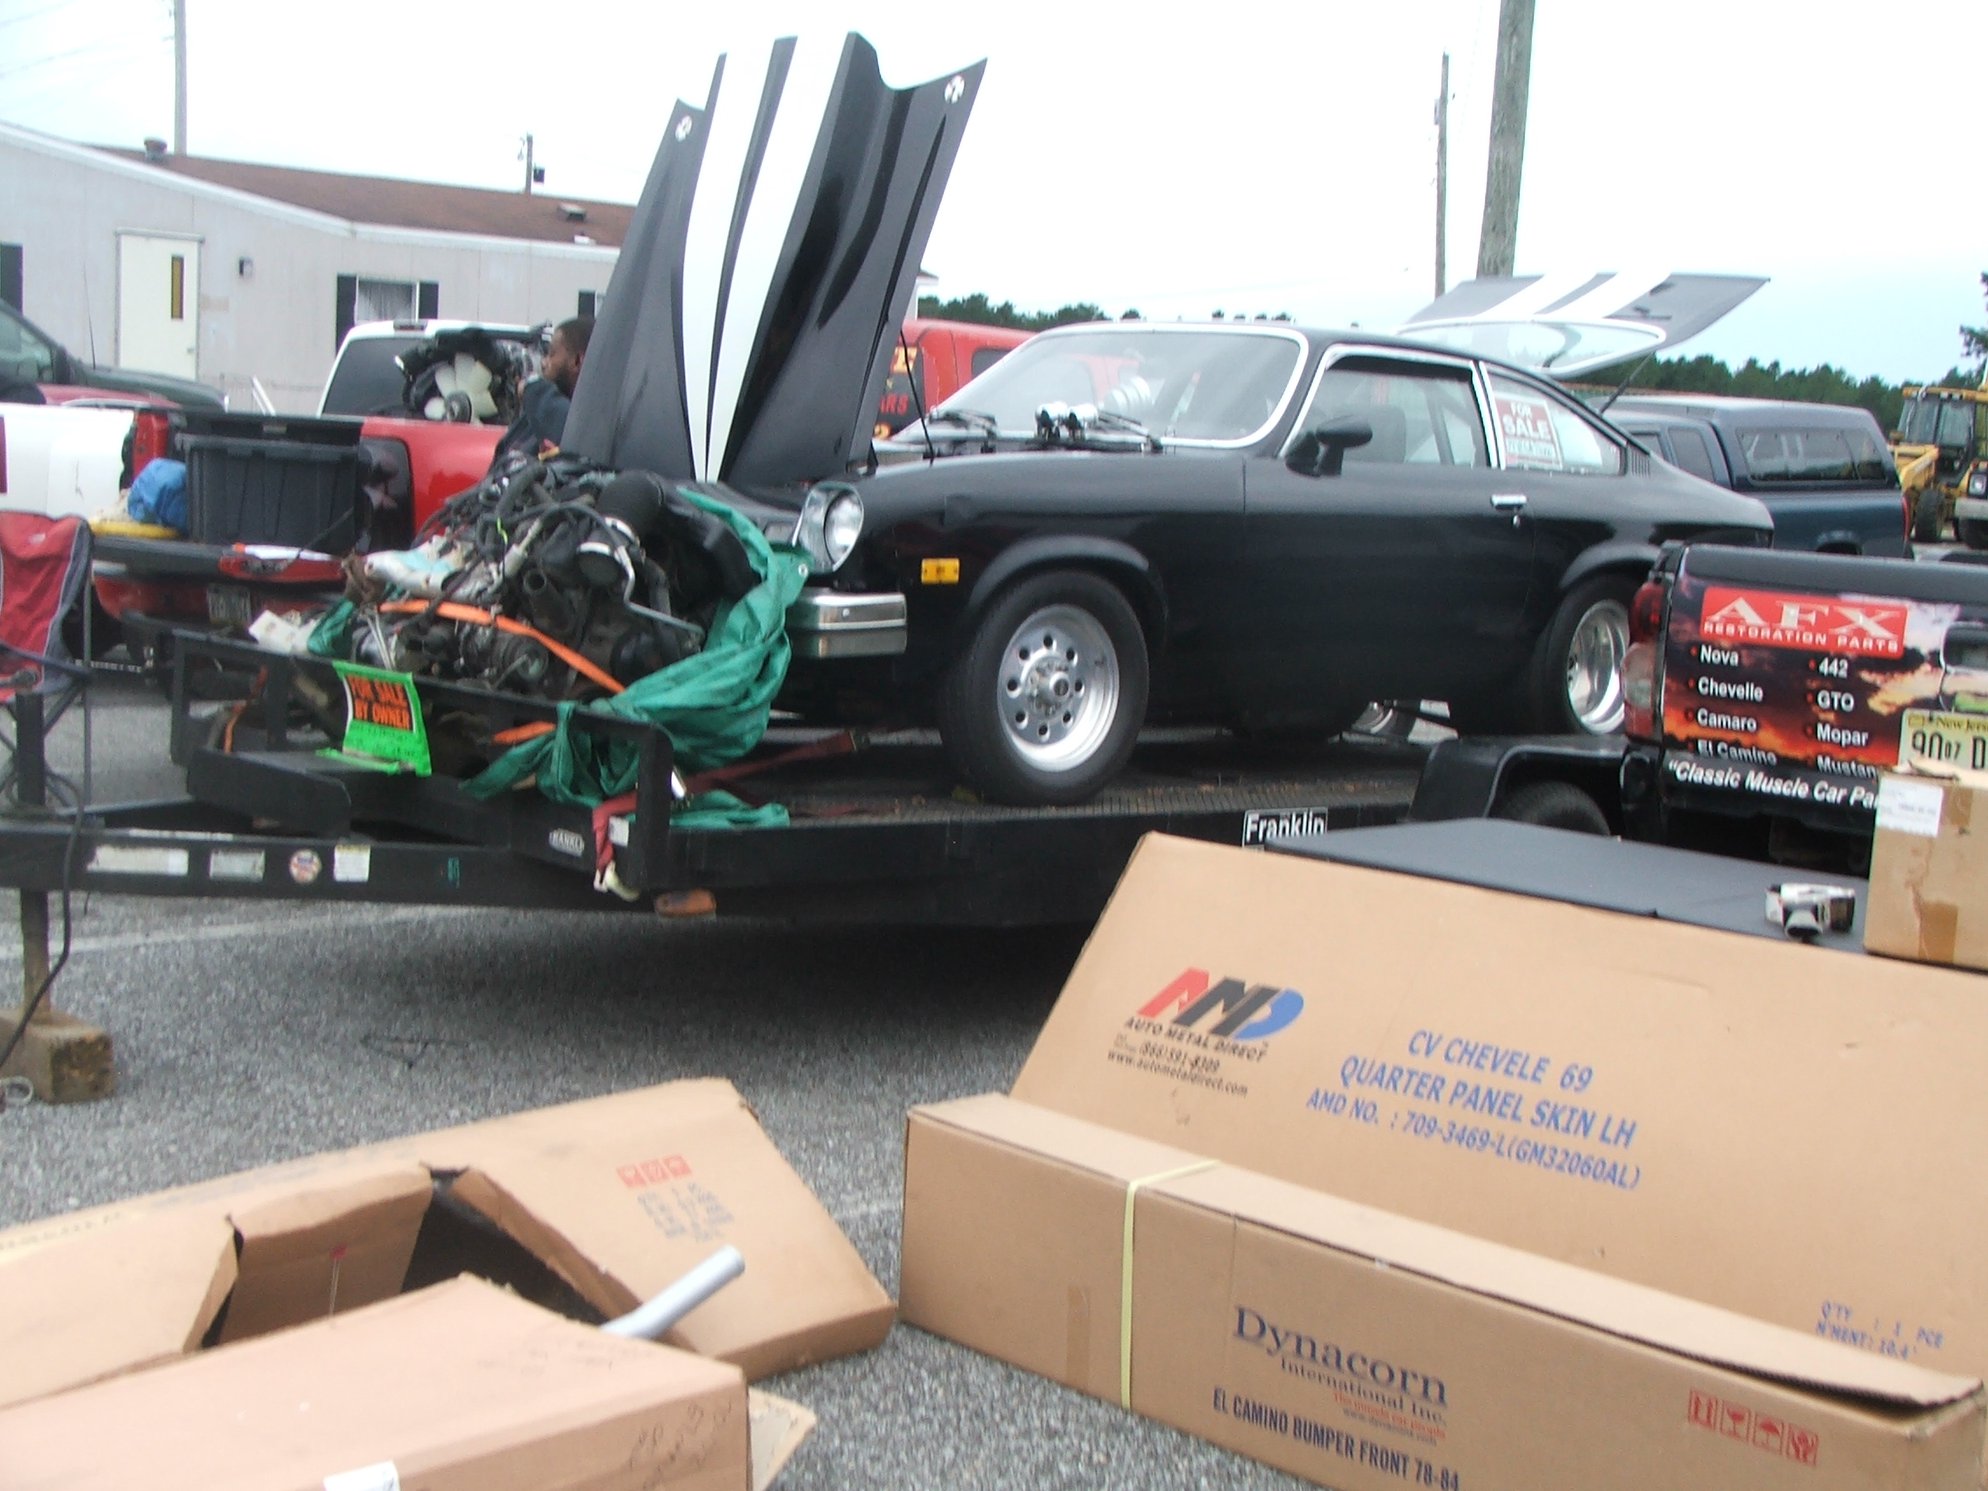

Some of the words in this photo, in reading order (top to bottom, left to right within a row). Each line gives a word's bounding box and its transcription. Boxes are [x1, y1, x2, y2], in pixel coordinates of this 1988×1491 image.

[1510, 401, 1532, 419] FOR
[1502, 414, 1552, 440] SALE
[1706, 596, 1899, 640] AFX
[1703, 621, 1828, 646] RESTORATION
[1837, 635, 1899, 654] PARTS
[1700, 643, 1739, 667] Nova
[1818, 658, 1849, 679] 442
[1697, 677, 1764, 703] Chevelle
[1816, 689, 1854, 713] GTO
[1697, 708, 1757, 733] Camaro
[1936, 716, 1961, 730] New
[1816, 723, 1868, 748] Mopar
[1698, 739, 1713, 758] El
[1717, 742, 1777, 767] Camino
[1816, 754, 1878, 779] Mustan
[1745, 769, 1809, 799] Muscle
[1813, 780, 1848, 804] Car
[1246, 810, 1325, 843] Franklin
[1125, 1016, 1163, 1034] AUTO
[1164, 1028, 1209, 1050] METAL
[1213, 1037, 1267, 1063] DIRECT
[1408, 1029, 1443, 1058] CV
[1443, 1037, 1551, 1084] CHEVELE
[1559, 1062, 1594, 1093] 69
[1306, 1087, 1347, 1116] AMD
[1340, 1055, 1446, 1103] QUARTER
[1449, 1080, 1524, 1123] PANEL
[1530, 1099, 1597, 1139] SKIN
[1600, 1113, 1638, 1150] LH
[1234, 1304, 1448, 1407] Dynacorn
[1280, 1357, 1404, 1410] International
[1212, 1385, 1229, 1414] EL
[1232, 1395, 1289, 1435] CAMINO
[1292, 1416, 1354, 1459] BUMPER
[1359, 1440, 1410, 1479] FRONT
[1414, 1456, 1461, 1491] 78-84
